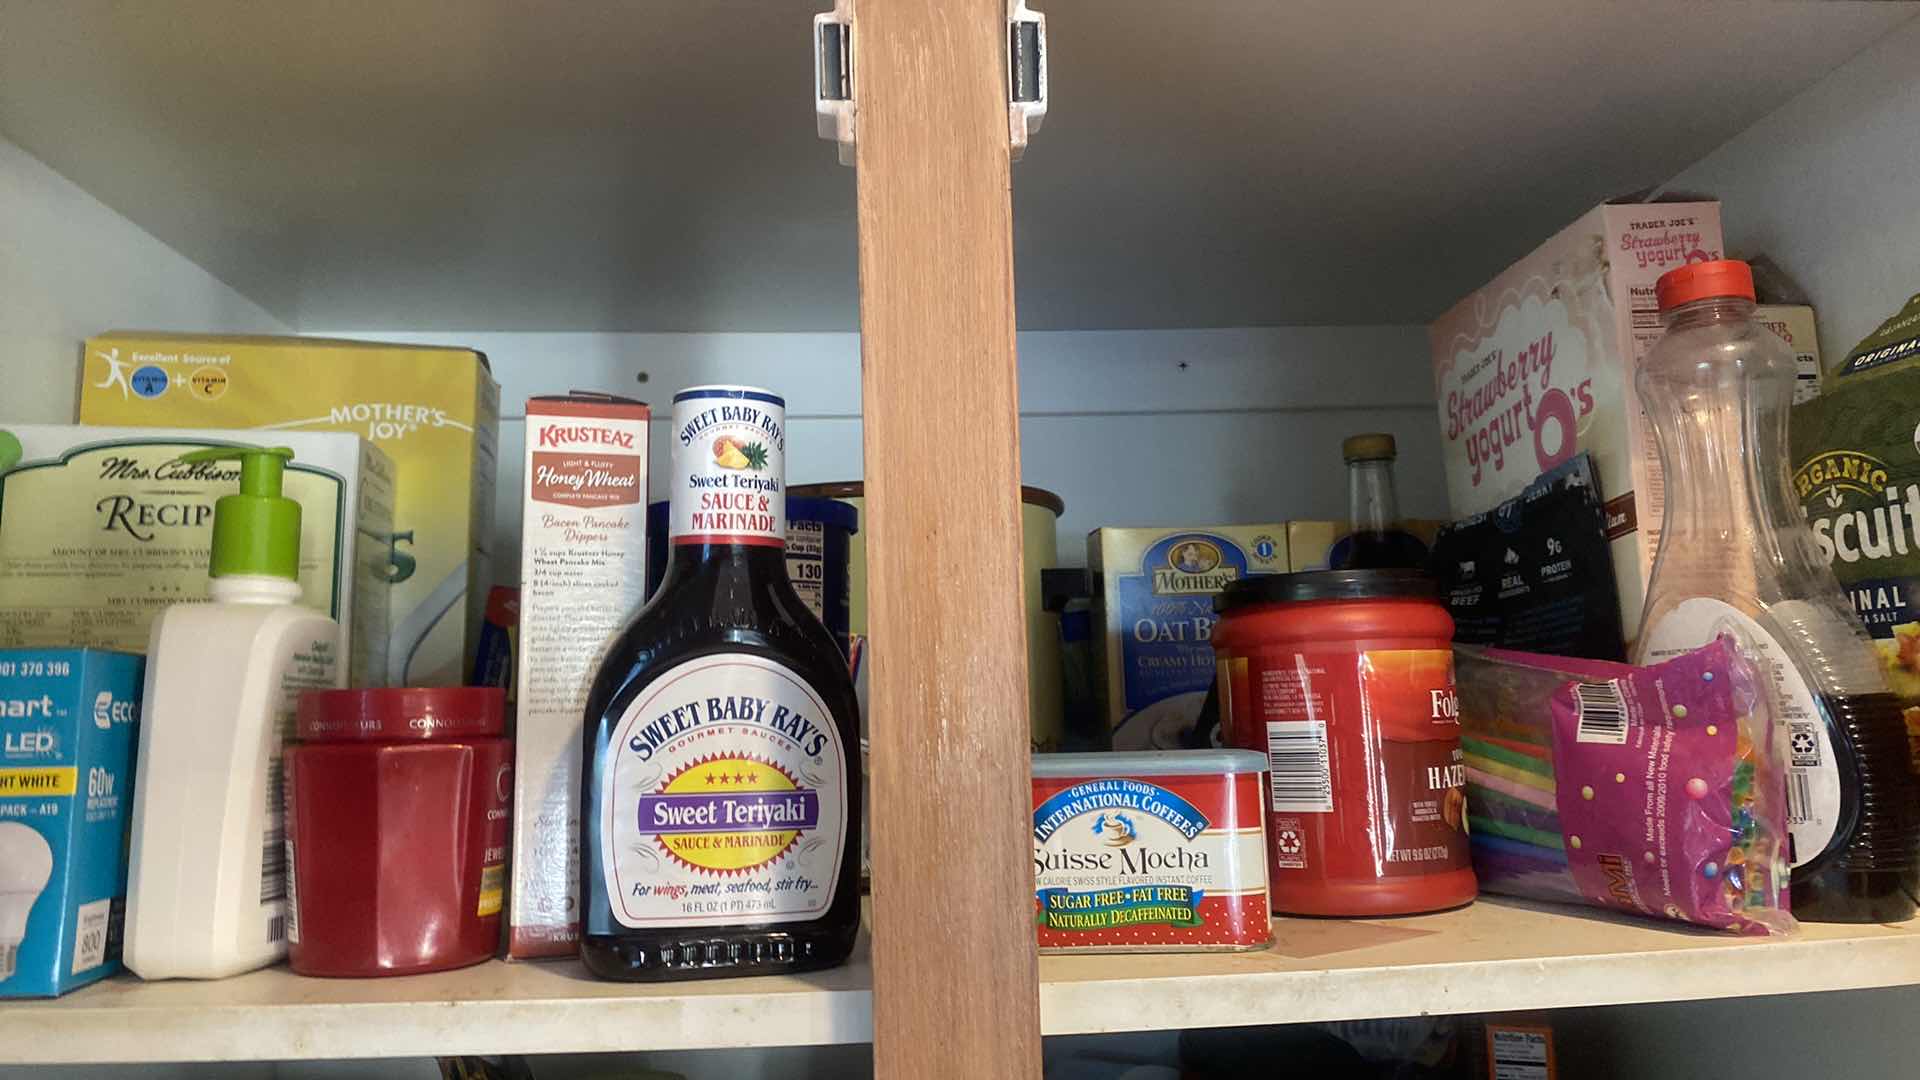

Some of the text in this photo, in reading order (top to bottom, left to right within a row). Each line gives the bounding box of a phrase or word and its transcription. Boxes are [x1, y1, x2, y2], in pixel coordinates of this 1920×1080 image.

[1630, 217, 1695, 230] TRADER JOE'S
[1620, 230, 1703, 250] Strawberry
[1636, 247, 1688, 268] yogurt
[132, 352, 231, 364] Excellent Source of
[145, 384, 154, 393] A
[204, 384, 213, 394] C
[1448, 331, 1554, 441] Strawberry
[330, 404, 447, 427] MOTHER'S
[368, 422, 408, 441] JOY
[539, 424, 634, 449] KRUSTEAZ
[680, 405, 784, 451] SWEET BABY RAY'S
[1465, 384, 1536, 488] yogurt
[100, 457, 150, 480] Mrs.
[563, 460, 582, 468] LIGHT
[536, 465, 636, 491] Honey Wheat
[689, 474, 779, 494] Sweet Teriyaki
[701, 493, 769, 512] SAUCE &
[542, 514, 630, 529] Bacon Pancake
[692, 513, 776, 533] MARINADE
[564, 529, 608, 545] Dippers
[796, 564, 822, 580] 130
[1155, 570, 1236, 592] MOTHER'S
[1874, 611, 1899, 624] SALT
[1135, 618, 1189, 643] OAT
[21, 662, 43, 676] 370
[629, 696, 828, 762] SWEET BABY RAY'S
[5, 732, 54, 753] LED
[668, 727, 793, 753] GOURMET SAUCES
[1662, 730, 1676, 754] safety
[1646, 760, 1657, 779] New
[1658, 753, 1670, 771] food
[19, 775, 61, 788] WHITE
[1071, 780, 1156, 798] GENERAL FOODS
[1645, 779, 1655, 791] all
[1644, 792, 1655, 815] From
[1656, 771, 1668, 817] 2009/2010
[653, 796, 806, 829] Sweet Teriyaki
[1035, 793, 1198, 840] INTERNATIONAL COFFEES
[1645, 816, 1655, 842] Made
[673, 835, 785, 851] SAUCE & MARINADE
[1034, 847, 1209, 875] Suisse Mocha
[632, 882, 651, 897] For
[653, 881, 689, 900] wings,
[690, 882, 722, 896] meat,
[724, 878, 771, 894] seafood,
[1072, 877, 1094, 886] SWISS
[1096, 877, 1117, 885] STYLE
[1118, 876, 1154, 885] FLAVORED
[1156, 875, 1186, 885] INSTANT
[1187, 875, 1213, 884] COFFEE
[682, 903, 691, 913] 16
[694, 902, 705, 913] FL
[707, 902, 718, 912] OZ
[1050, 886, 1189, 909] SUGAR FREE FAT FREE
[1049, 906, 1192, 928] NATURALLY DECAFFEINATED
